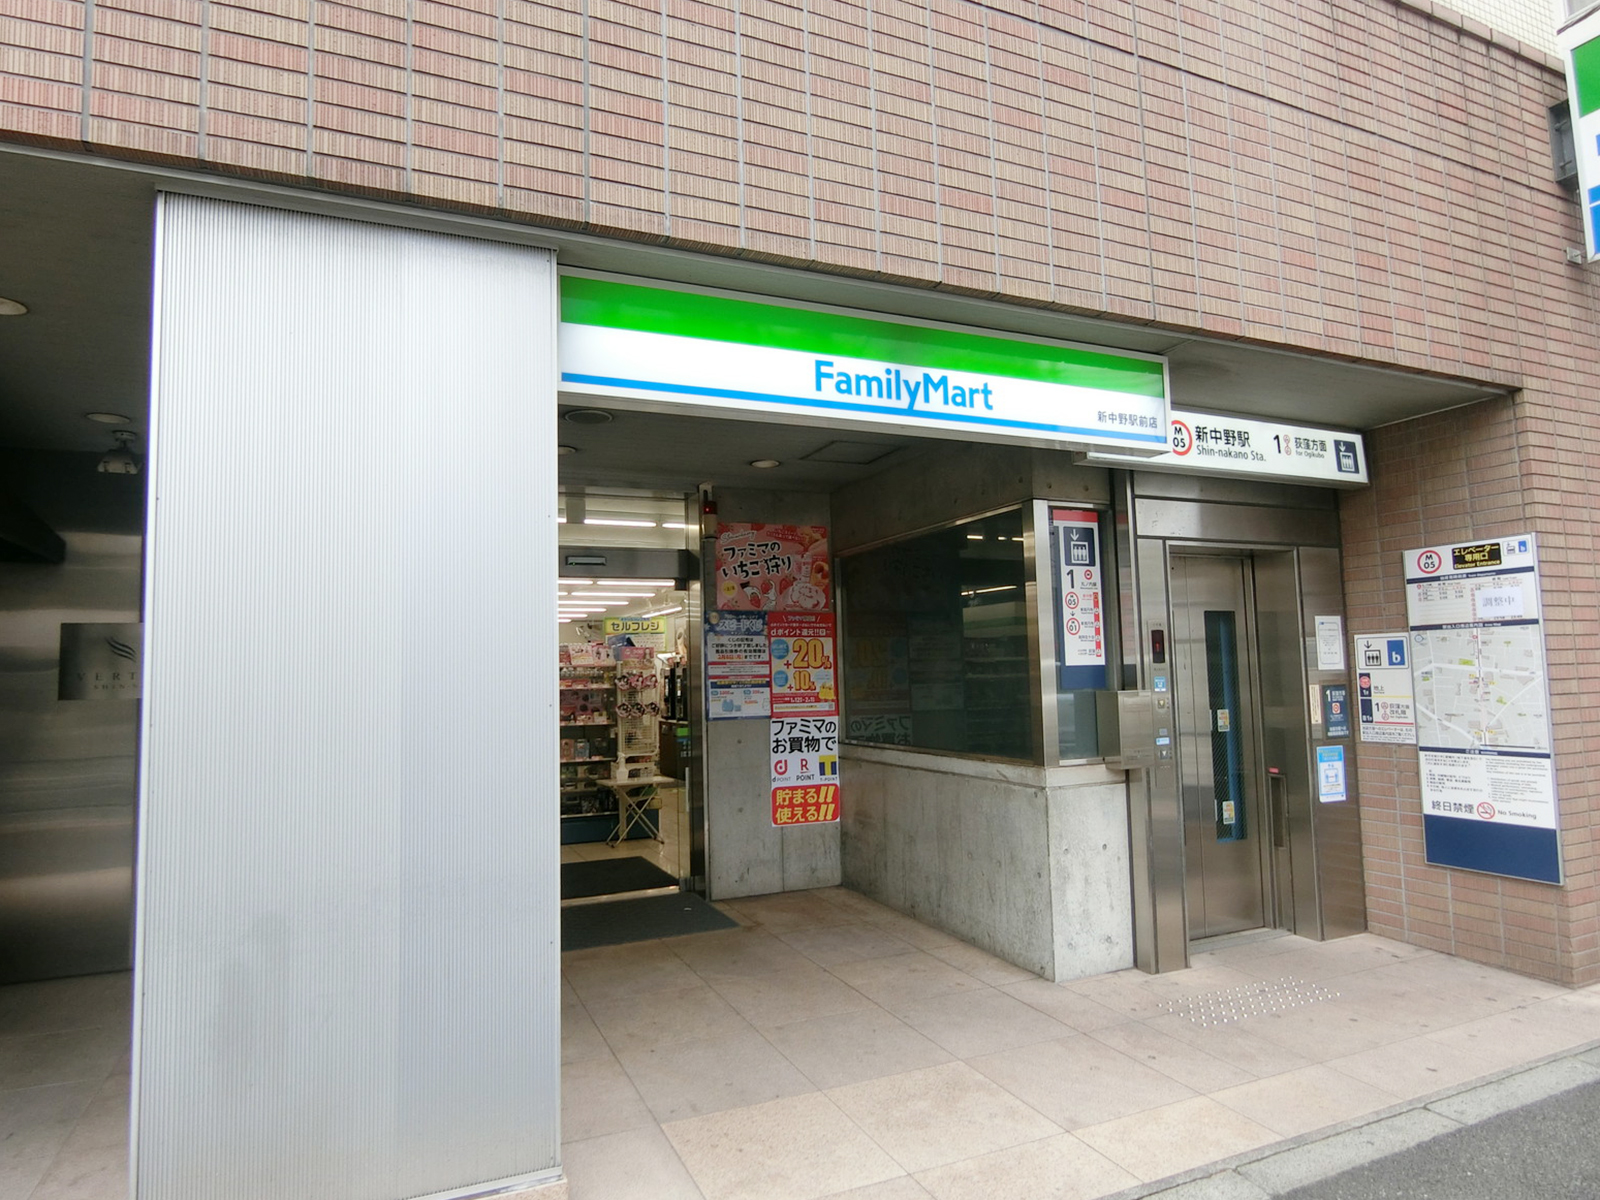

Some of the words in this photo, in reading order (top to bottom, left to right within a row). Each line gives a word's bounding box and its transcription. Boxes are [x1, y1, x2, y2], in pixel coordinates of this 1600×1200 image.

[815, 359, 994, 411] FamilyMart
[1097, 410, 1159, 429] 新中野駅前店
[1174, 426, 1184, 436] M
[1195, 425, 1251, 447] 新中野駅
[1172, 437, 1186, 449] 05
[1273, 434, 1282, 454] 1
[1294, 436, 1327, 453] 荻窪方面
[1196, 446, 1249, 461] Shin-nakano
[1250, 451, 1267, 462] Sta.
[723, 540, 781, 561] ファミマの
[1453, 544, 1500, 557] エレベーター
[1464, 552, 1489, 562] 専用口
[721, 554, 792, 580] いちご狩り
[1423, 561, 1436, 569] 05
[1066, 569, 1075, 589] 1
[1067, 598, 1077, 606] 05
[611, 621, 660, 632] セルフレジ
[1068, 624, 1077, 632] 01
[1392, 651, 1401, 663] b
[1325, 689, 1332, 702] 1
[1375, 702, 1380, 712] 1
[771, 718, 837, 736] ファミマの
[771, 735, 837, 754] お買物で
[796, 774, 815, 782] POINT
[775, 785, 836, 806] 貯まる!!
[775, 803, 835, 824] 使える!!
[1431, 800, 1475, 815] 終日禁煙
[1508, 810, 1538, 820] Smoking
